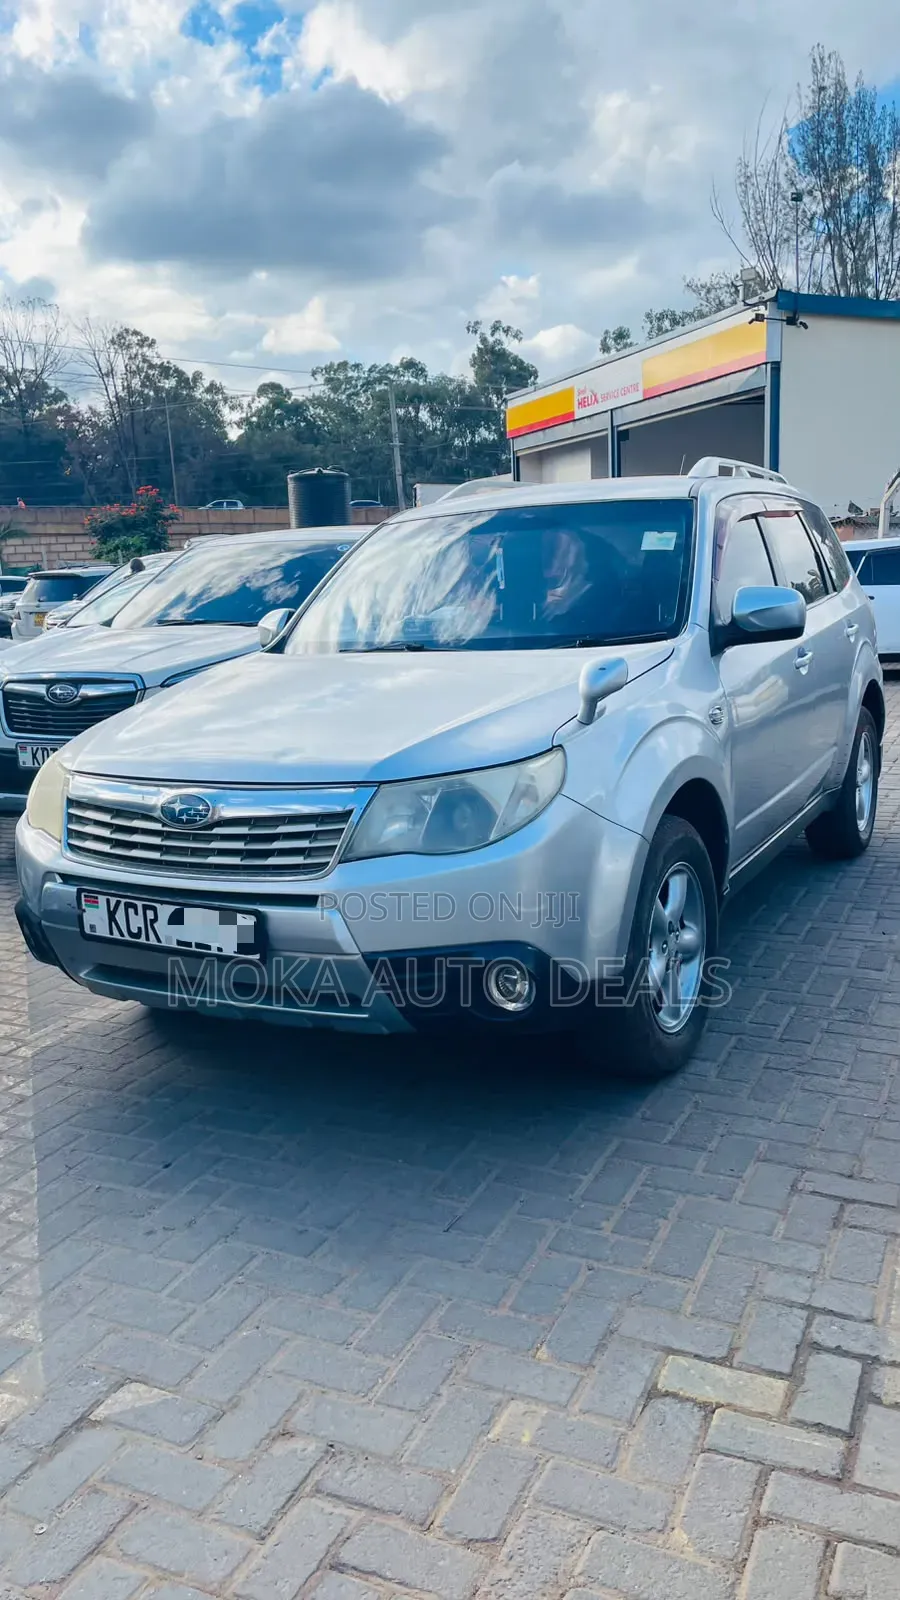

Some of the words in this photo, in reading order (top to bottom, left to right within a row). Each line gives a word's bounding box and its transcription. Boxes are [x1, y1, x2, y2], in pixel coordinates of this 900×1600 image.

[577, 391, 599, 410] HELIX
[600, 388, 620, 403] SERVICE
[620, 382, 640, 397] CENTRE
[31, 746, 59, 766] KD
[105, 897, 162, 944] KCR
